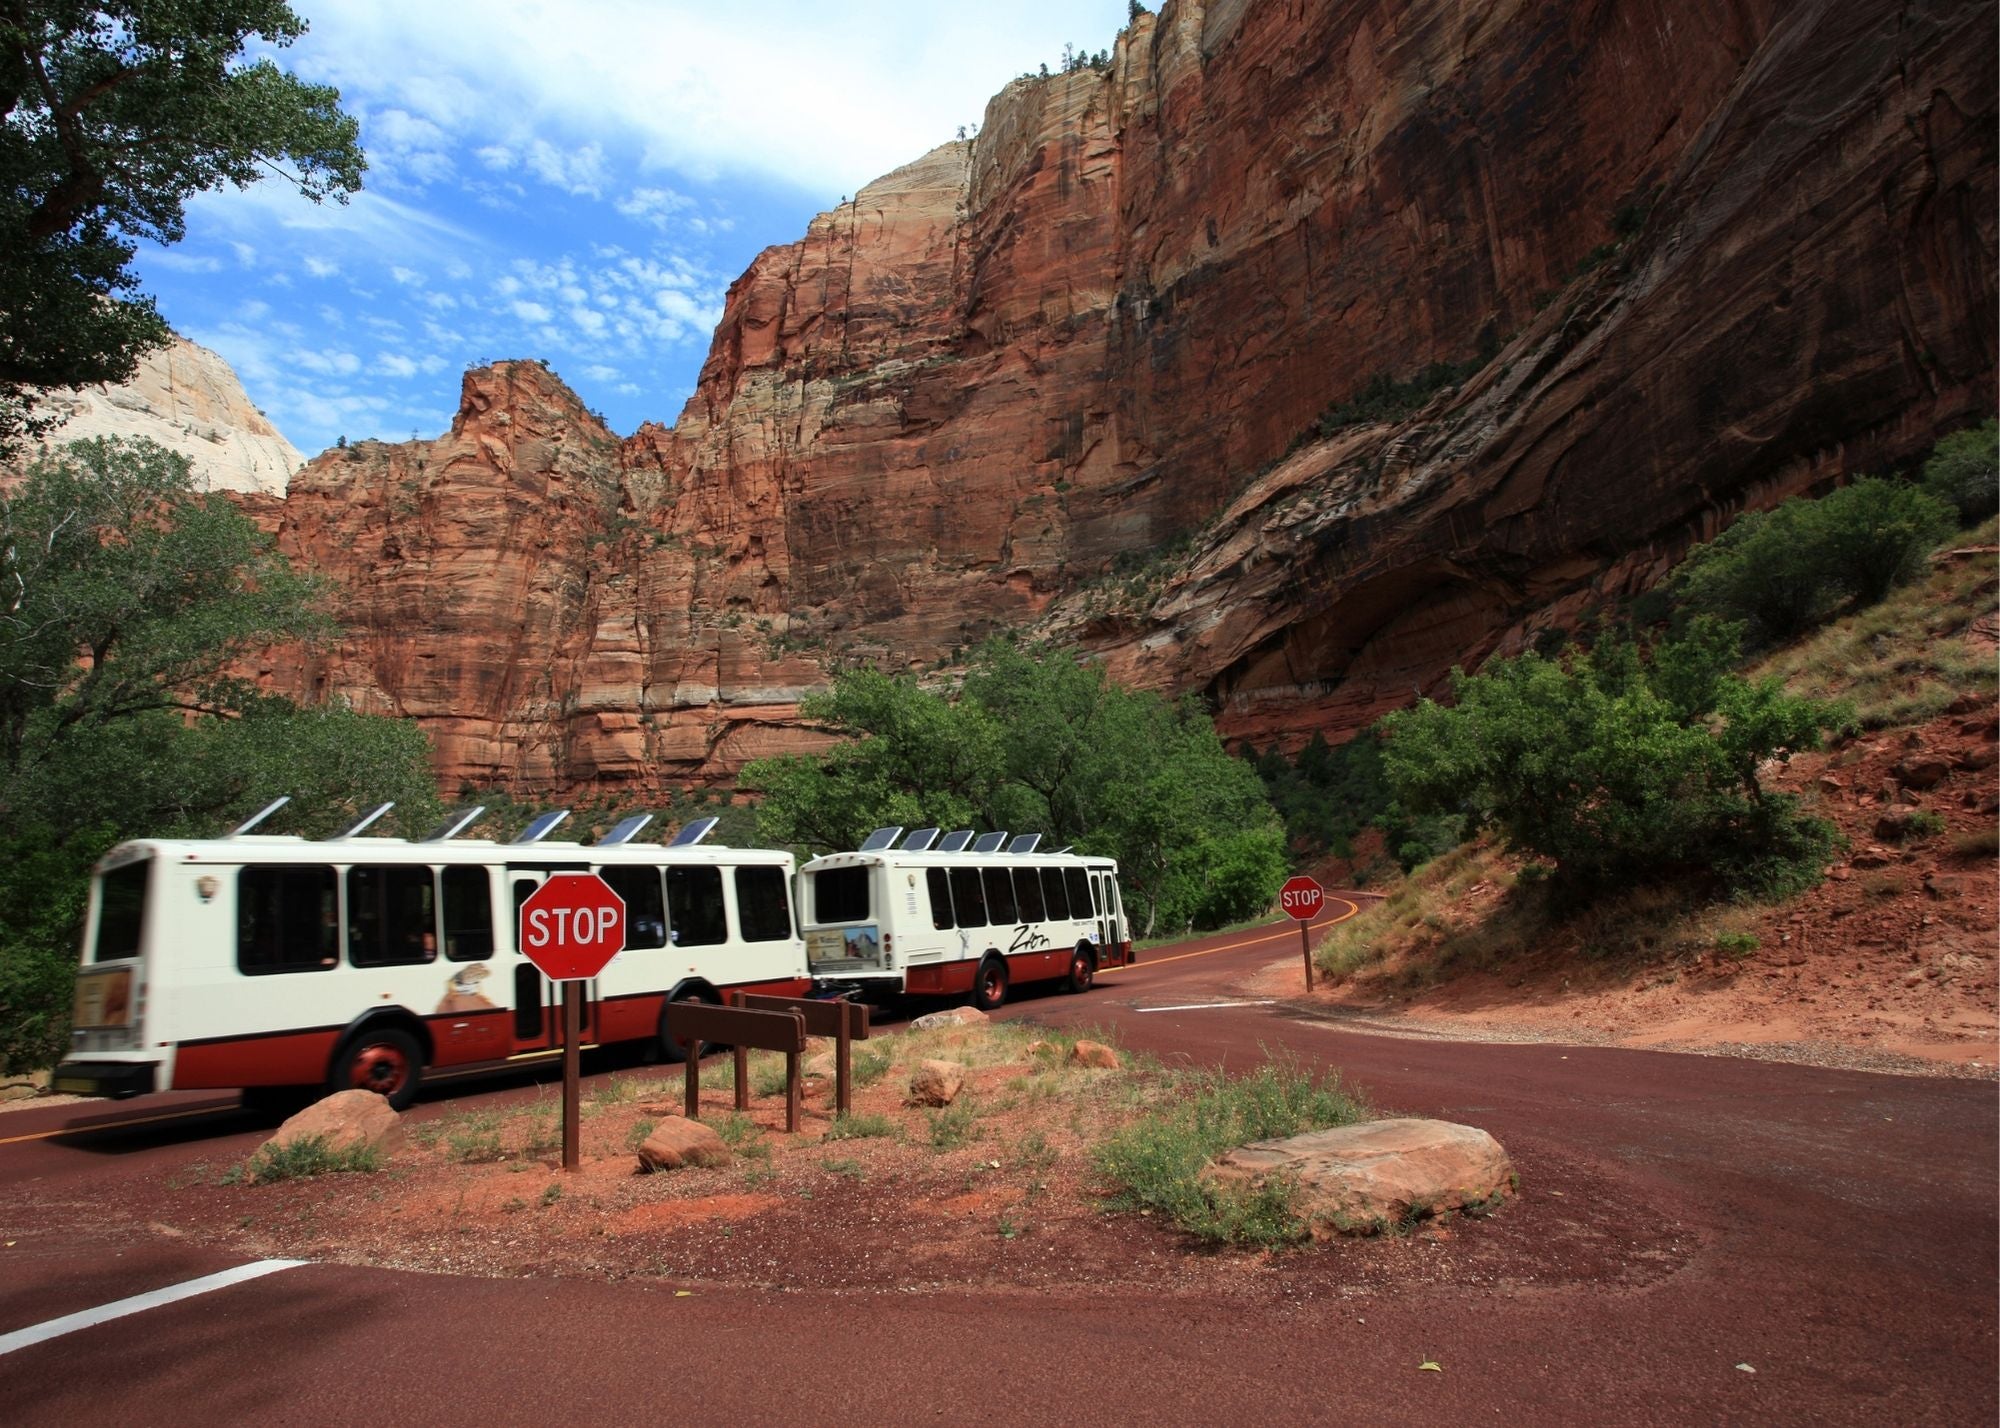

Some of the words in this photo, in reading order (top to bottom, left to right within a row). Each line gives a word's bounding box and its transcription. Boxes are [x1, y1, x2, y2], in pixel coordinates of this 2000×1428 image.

[1283, 889, 1320, 907] STOP
[528, 907, 618, 946] STOP
[1009, 924, 1050, 953] Zion
